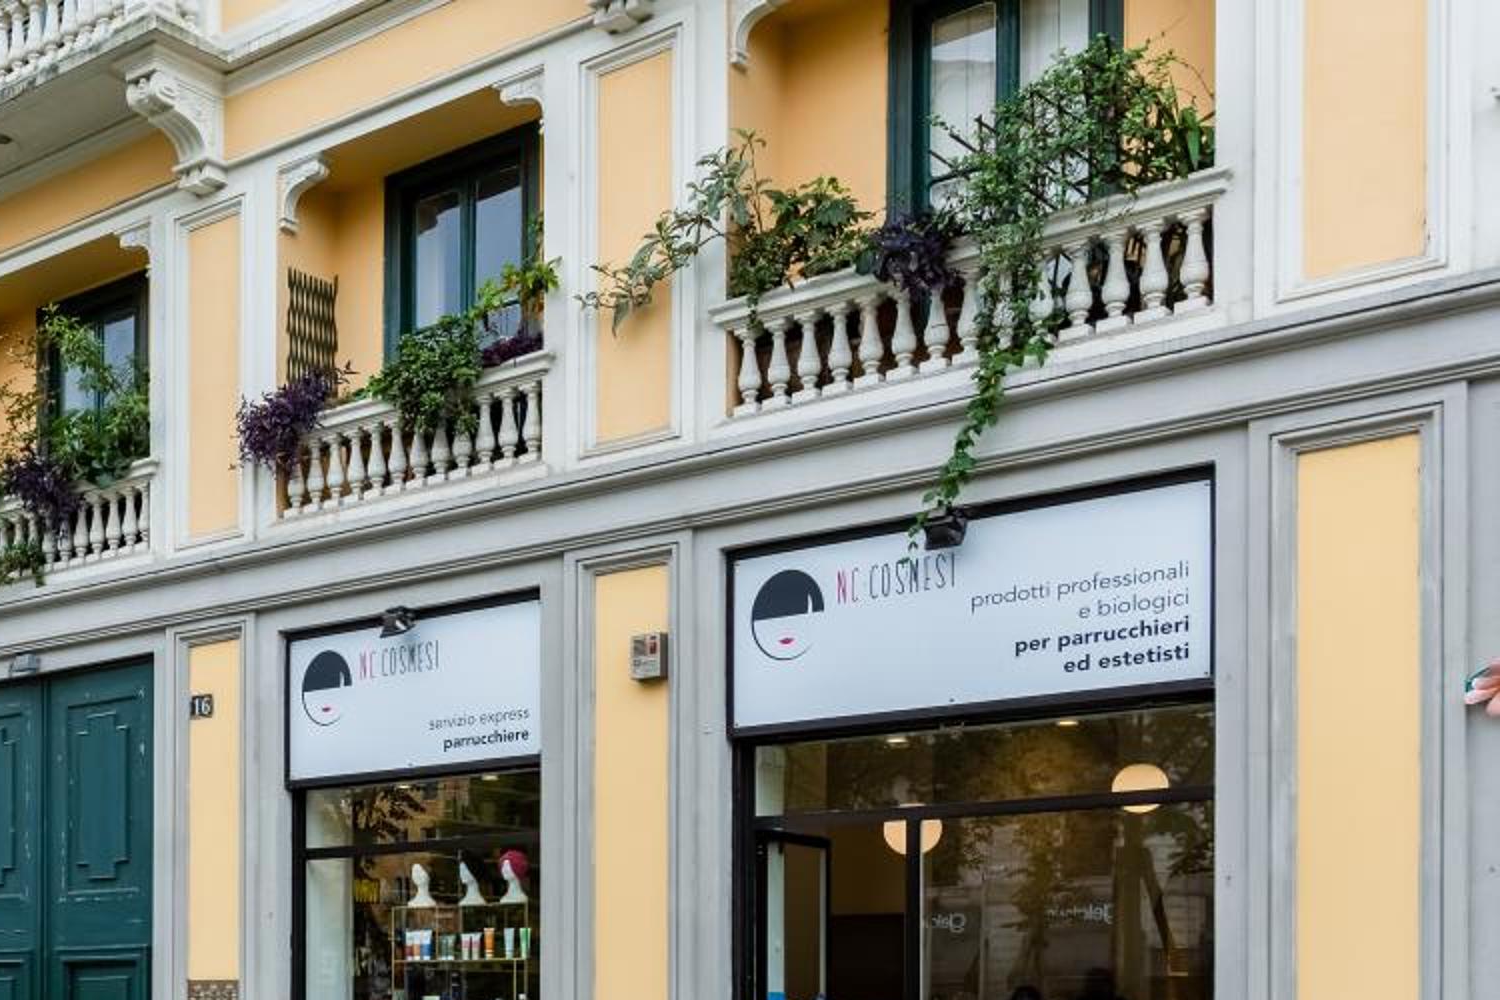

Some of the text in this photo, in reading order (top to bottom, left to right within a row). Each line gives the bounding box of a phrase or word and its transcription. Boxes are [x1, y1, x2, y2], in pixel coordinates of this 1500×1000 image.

[837, 551, 955, 604] NC COSMESI
[971, 560, 1190, 615] prodotti professionali
[1079, 588, 1190, 619] e biologici
[1015, 615, 1190, 657] per parrucchieri
[359, 639, 439, 680] NC COSMESI
[1064, 643, 1190, 673] ed estetisti
[194, 697, 211, 715] 16
[429, 708, 530, 730] servizio express
[443, 729, 529, 752] parrucchiere
